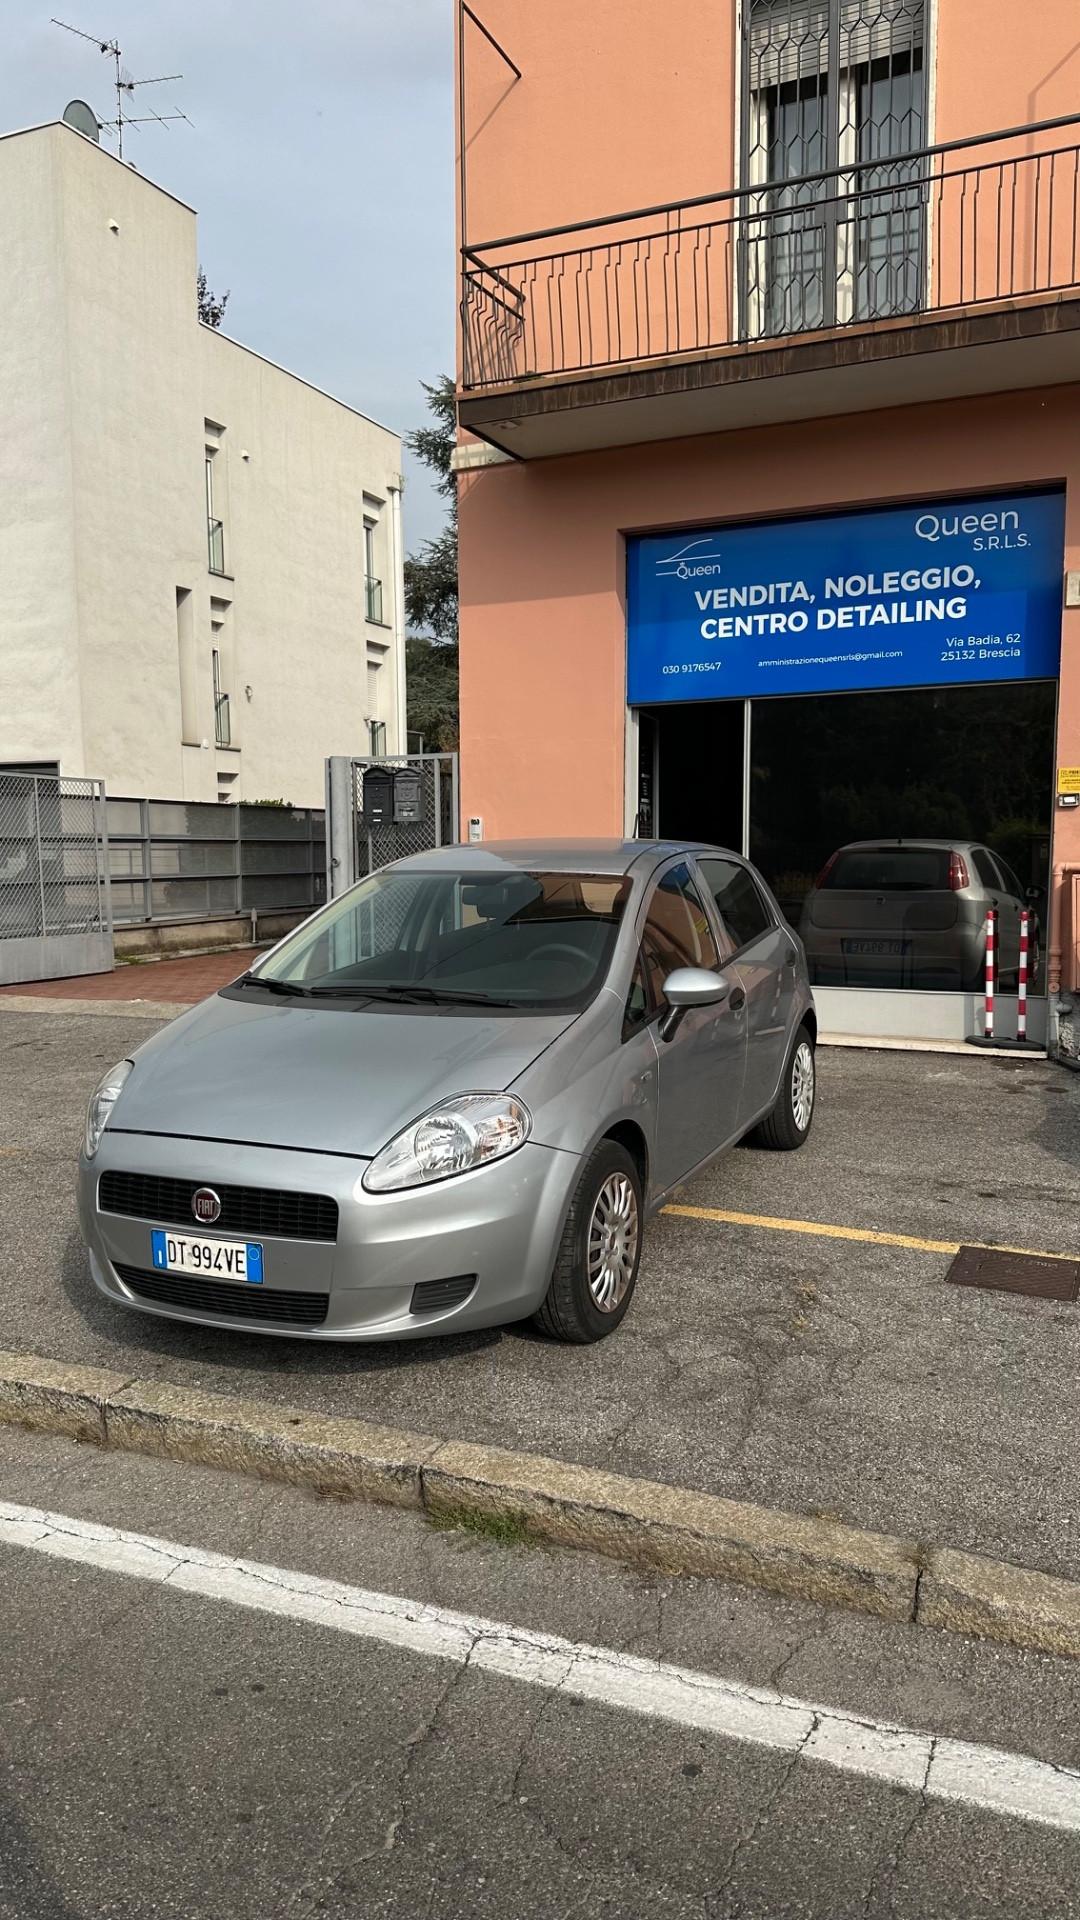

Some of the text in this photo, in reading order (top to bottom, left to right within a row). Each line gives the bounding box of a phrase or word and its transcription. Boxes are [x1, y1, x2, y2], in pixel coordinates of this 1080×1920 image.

[915, 510, 1019, 541] Queen
[972, 533, 1032, 551] S.R.L.S.
[676, 562, 721, 579] Queen
[694, 565, 981, 611] VENDITA, NOLEGGIO,
[700, 597, 967, 639] CENTRO DETAILING
[946, 633, 1021, 647] Via Badia, 62
[757, 650, 903, 668] amministrazionequeensrls@gmail.com
[940, 648, 1021, 661] 25132 Brescia
[662, 662, 722, 675] 030 9176547
[197, 1199, 215, 1215] FIAT
[167, 1239, 186, 1265] DT
[192, 1244, 245, 1274] 994VE
